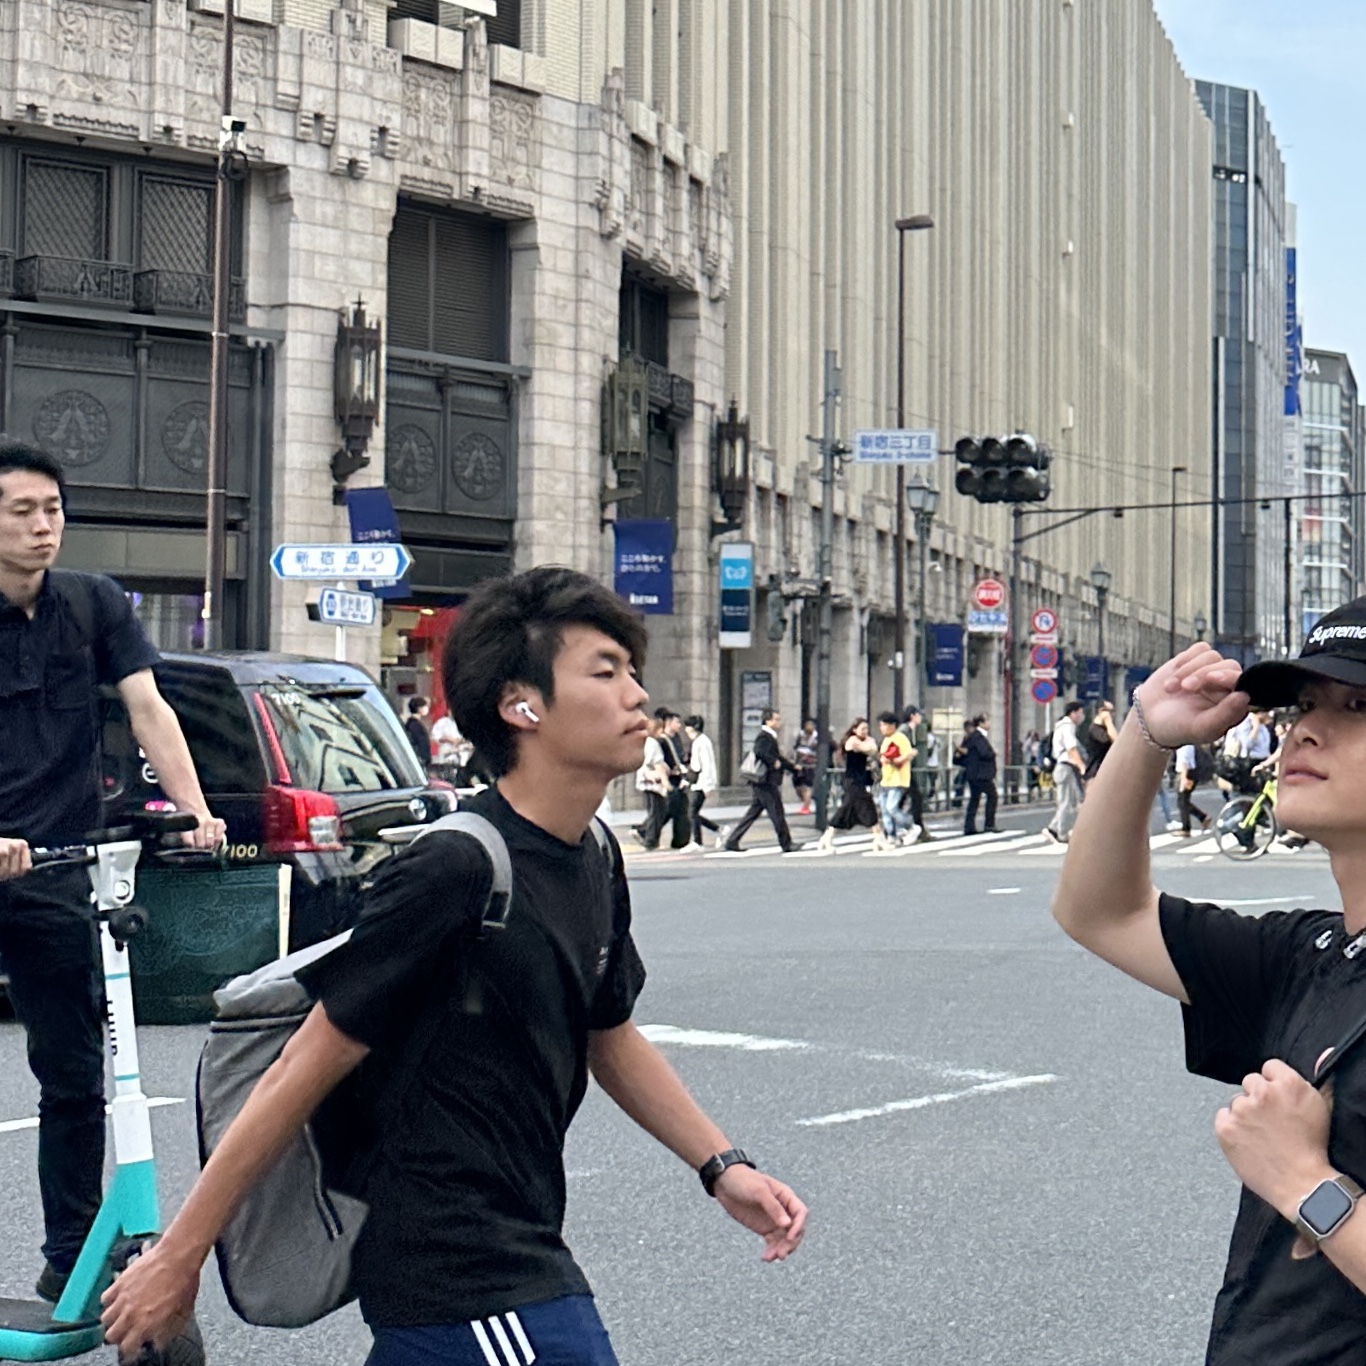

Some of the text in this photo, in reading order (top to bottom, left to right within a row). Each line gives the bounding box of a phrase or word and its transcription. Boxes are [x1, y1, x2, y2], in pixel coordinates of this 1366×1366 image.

[860, 434, 931, 450] 新宿三丁目
[296, 550, 384, 566] 新宿通り
